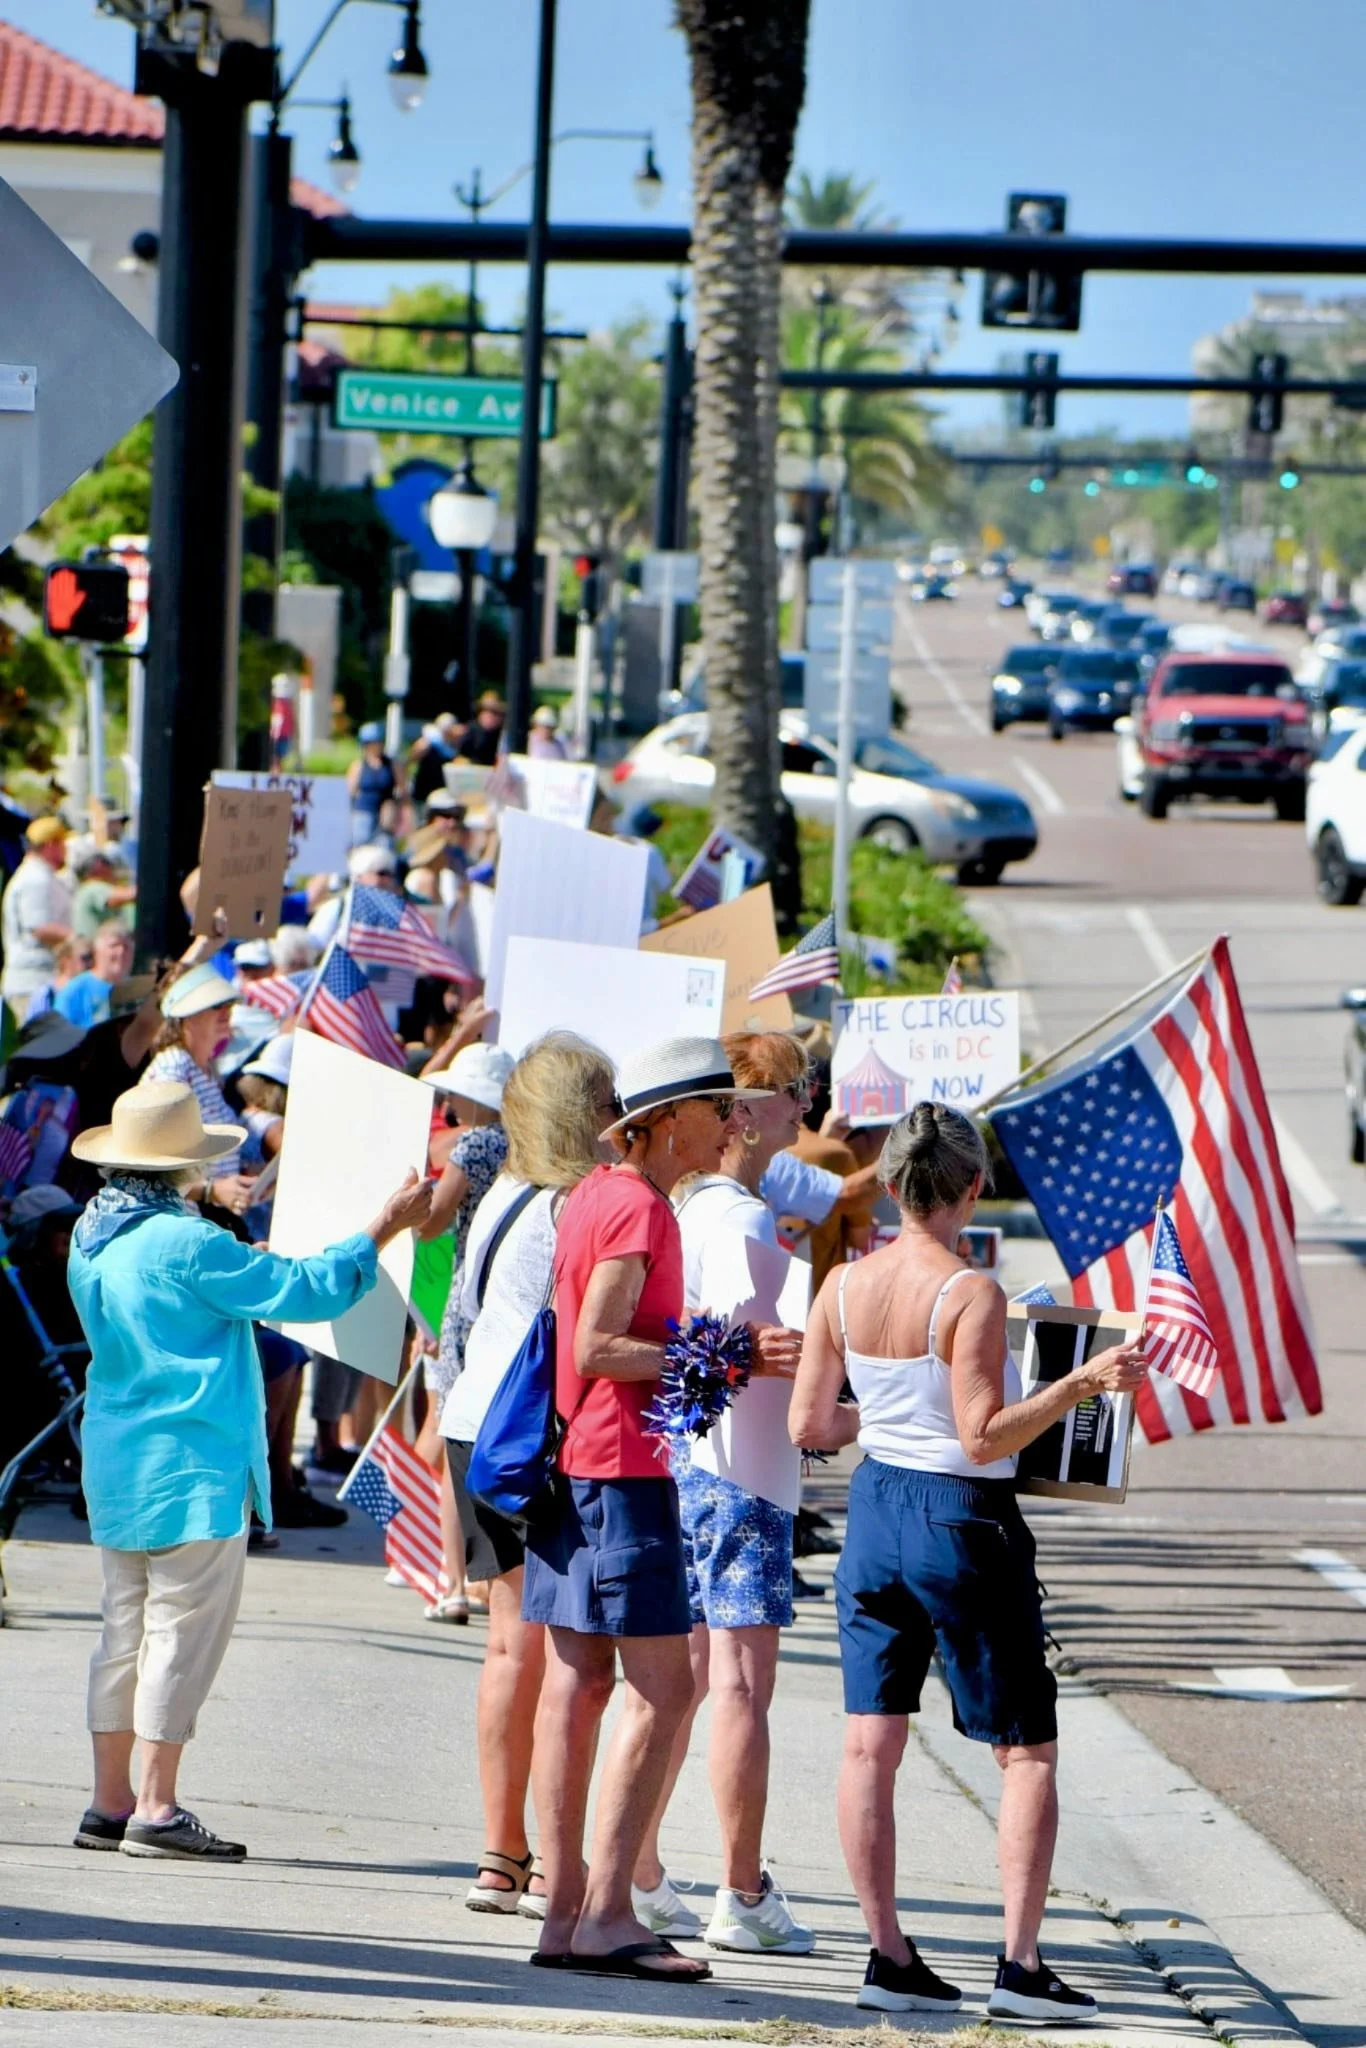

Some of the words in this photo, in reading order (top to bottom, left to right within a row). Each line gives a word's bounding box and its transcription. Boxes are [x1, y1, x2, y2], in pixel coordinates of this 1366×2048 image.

[350, 386, 460, 420] Venice
[478, 394, 523, 421] Av
[837, 1001, 889, 1032] THE
[901, 998, 1005, 1030] CIRCUS
[908, 1037, 925, 1061] is
[932, 1038, 950, 1061] in
[955, 1035, 994, 1062] DC
[931, 1073, 984, 1099] NOW
